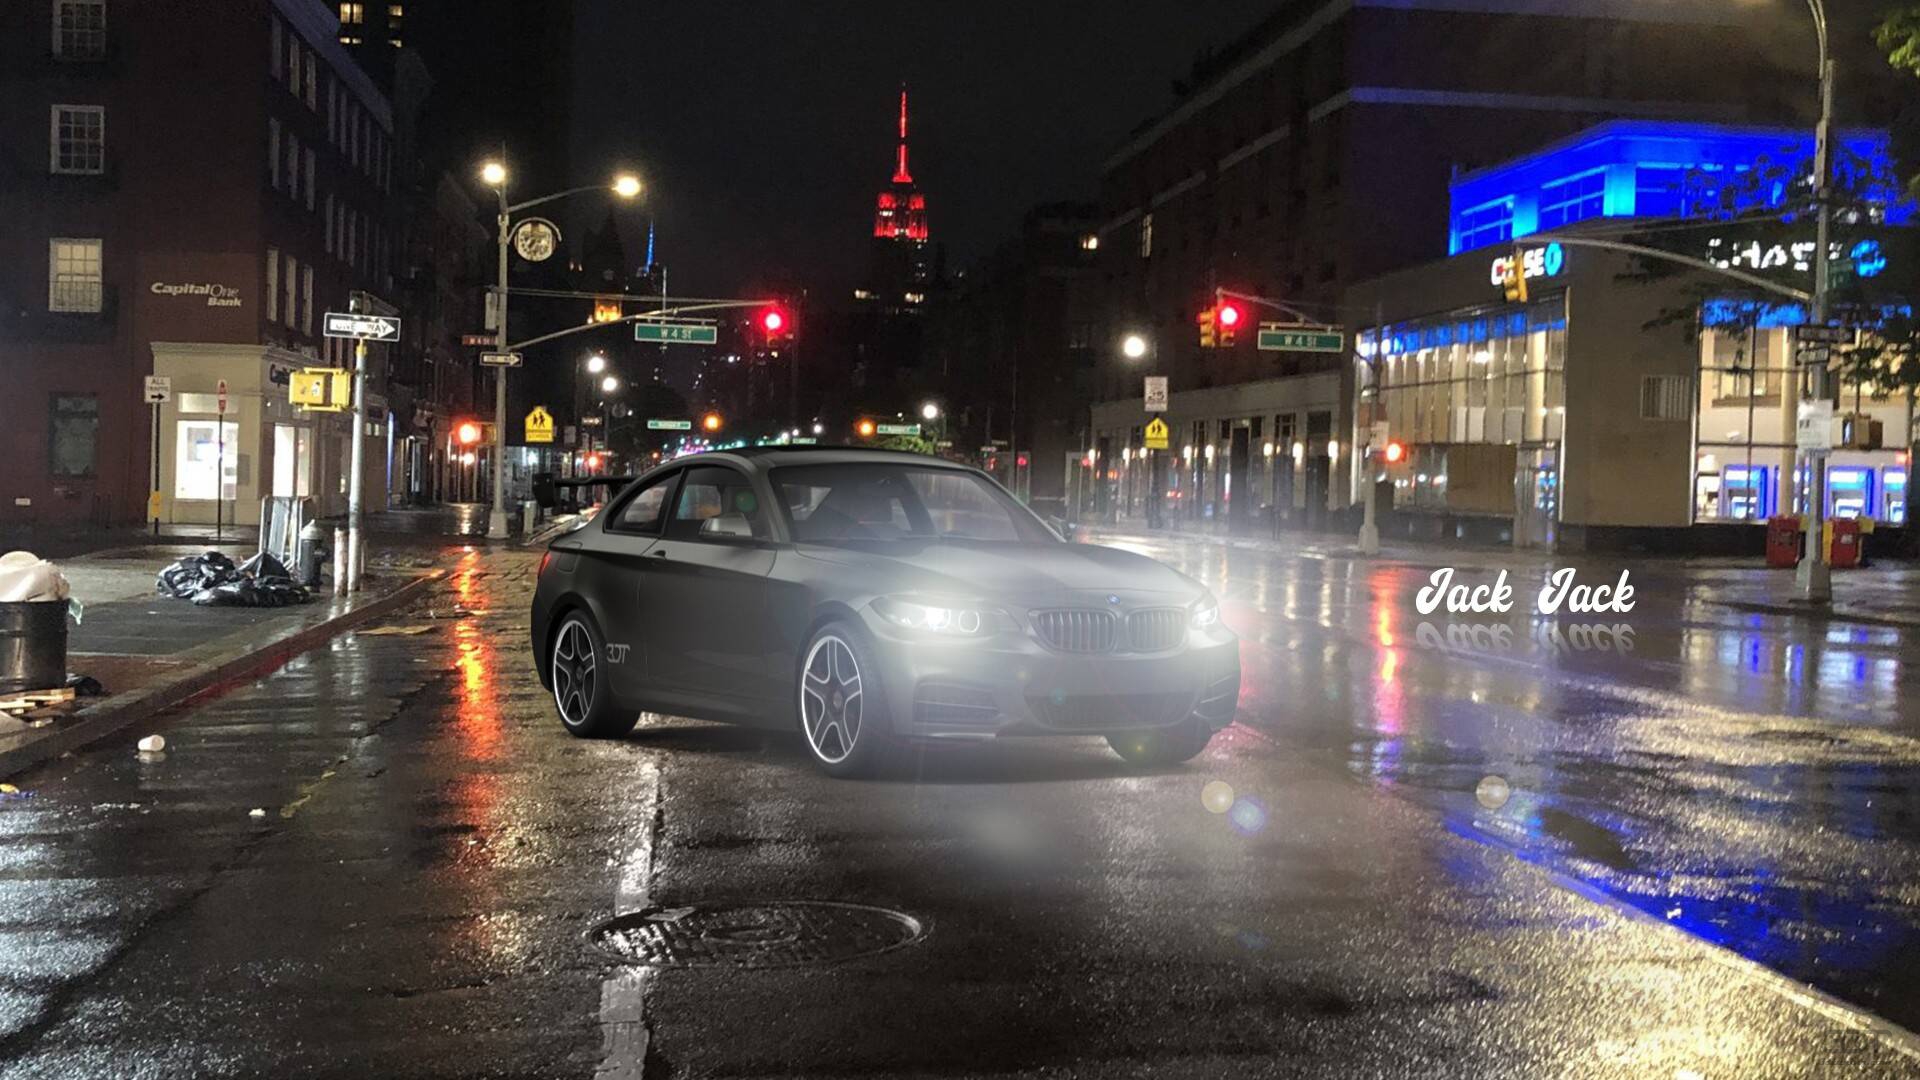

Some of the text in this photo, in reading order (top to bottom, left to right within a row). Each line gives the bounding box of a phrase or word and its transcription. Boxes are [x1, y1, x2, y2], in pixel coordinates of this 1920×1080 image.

[1491, 248, 1545, 286] CHSE
[207, 296, 242, 307] Bank
[367, 323, 388, 333] WAY
[660, 328, 669, 338] W
[671, 328, 679, 340] 4
[1284, 335, 1293, 345] W
[1295, 336, 1303, 347] 4
